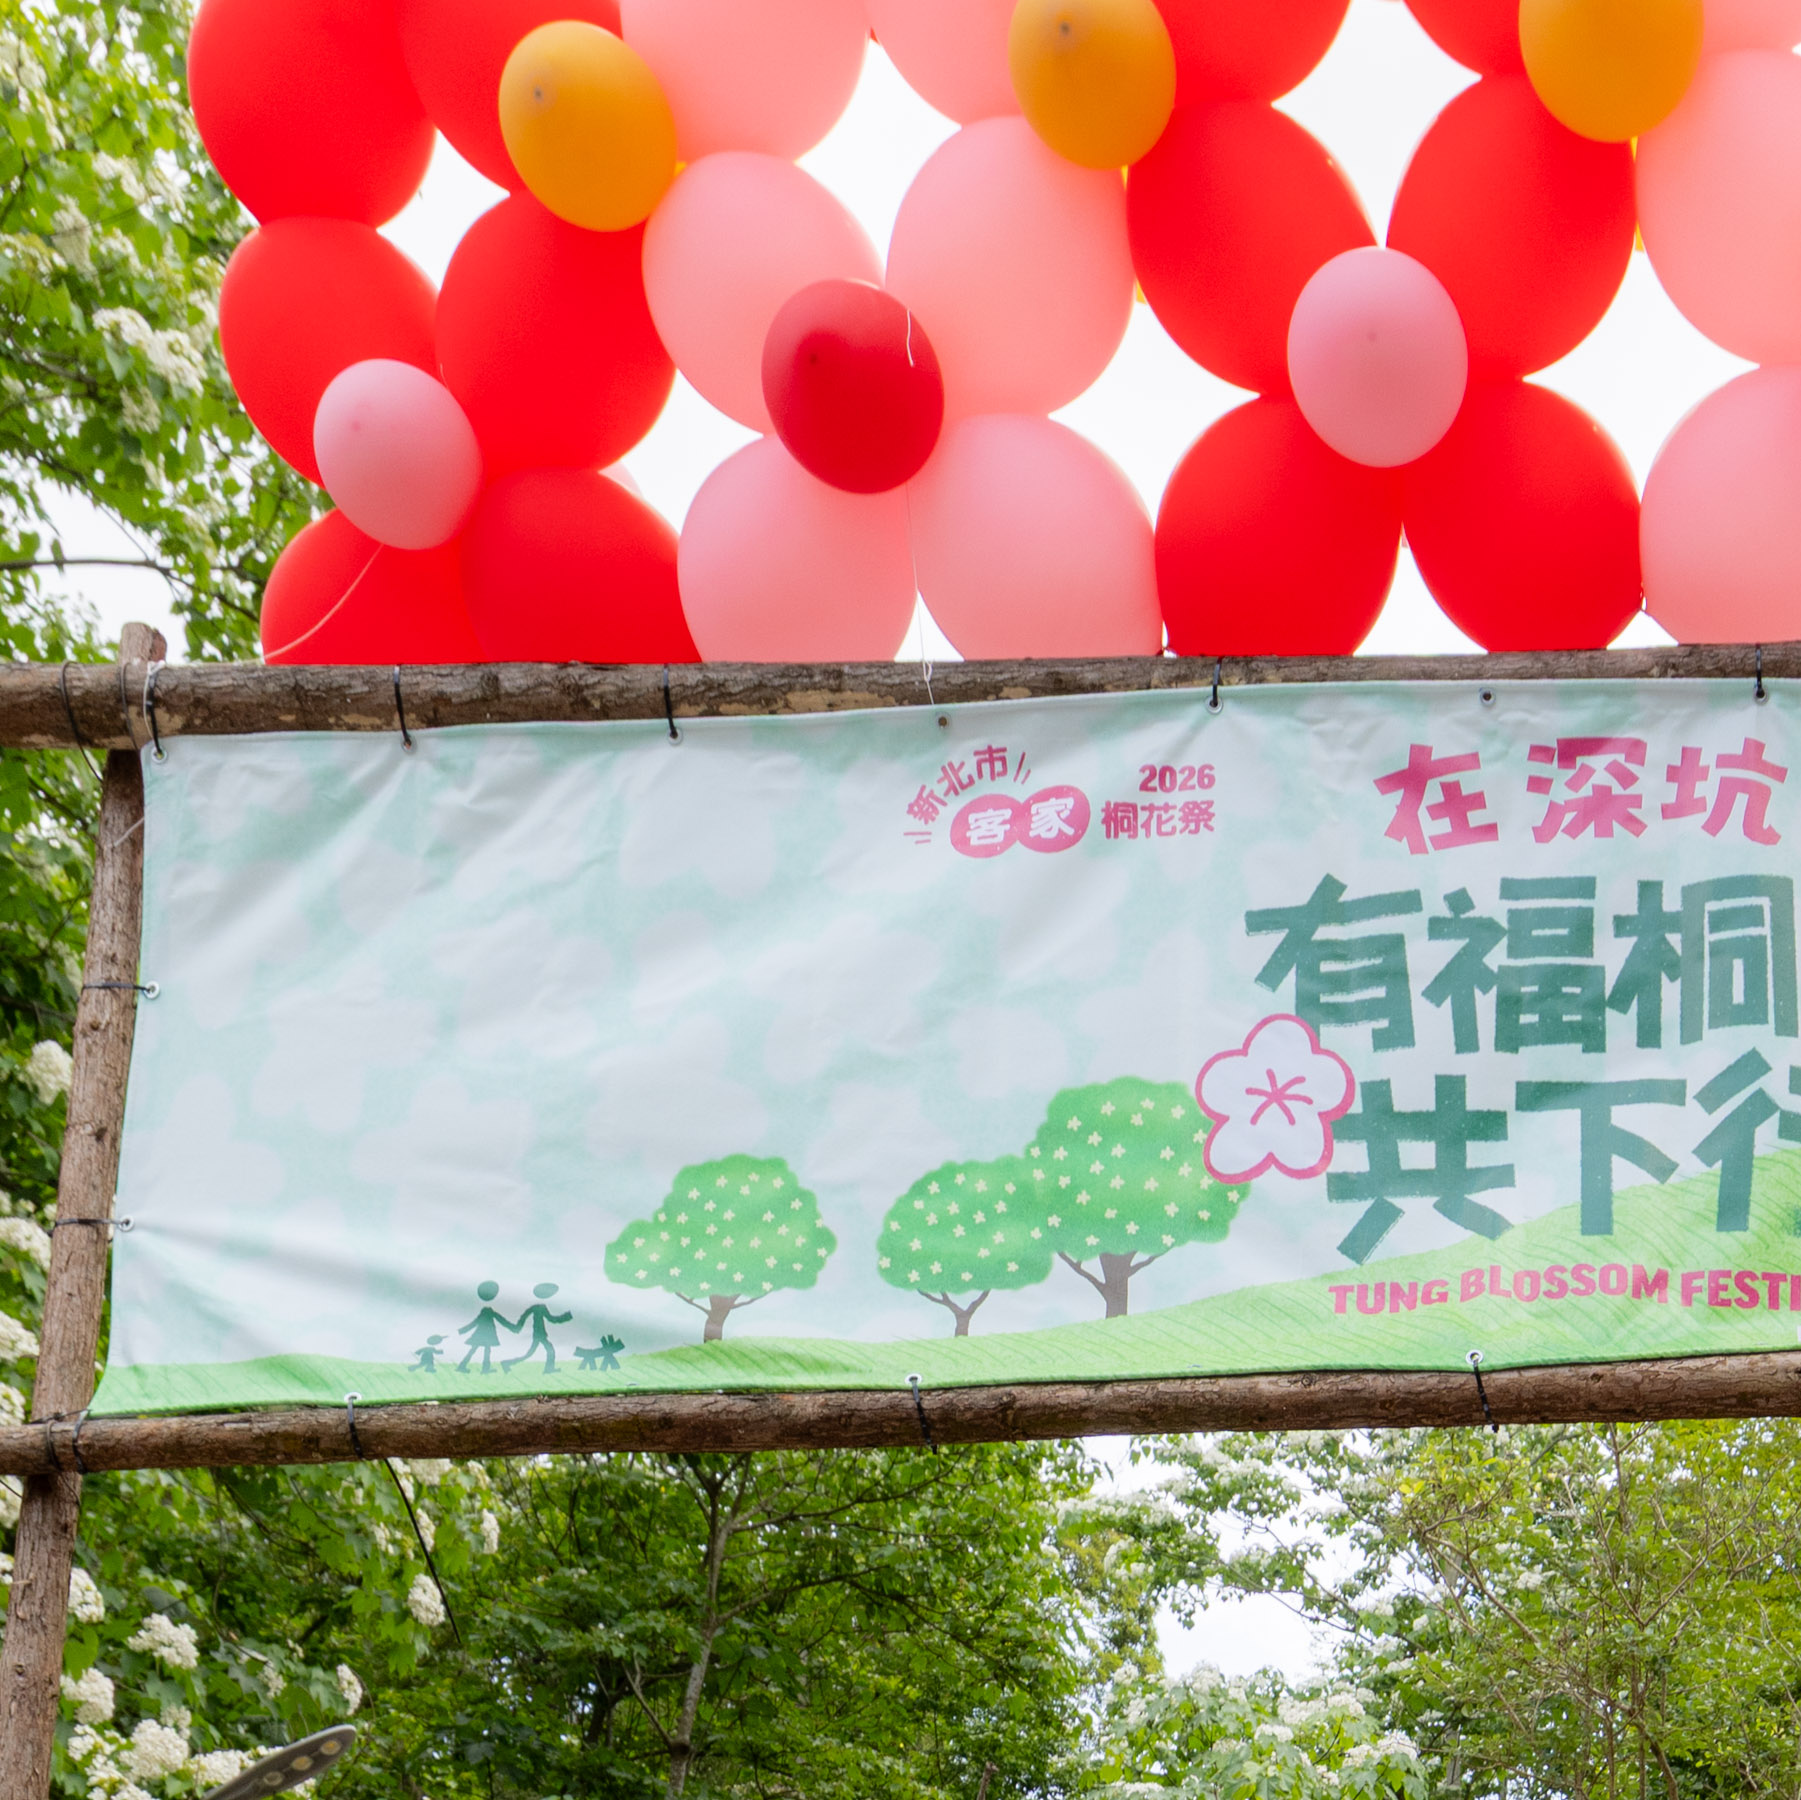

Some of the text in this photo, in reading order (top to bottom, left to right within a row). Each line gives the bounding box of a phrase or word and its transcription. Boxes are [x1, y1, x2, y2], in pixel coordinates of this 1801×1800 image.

[906, 744, 1008, 826] 新北市
[1139, 763, 1216, 793] 2026
[1374, 736, 1788, 854] 在深坑
[965, 796, 1216, 846] 客家 桐花祭
[1328, 1279, 1450, 1315] TUNG
[1460, 1263, 1669, 1304] BLOSSOM
